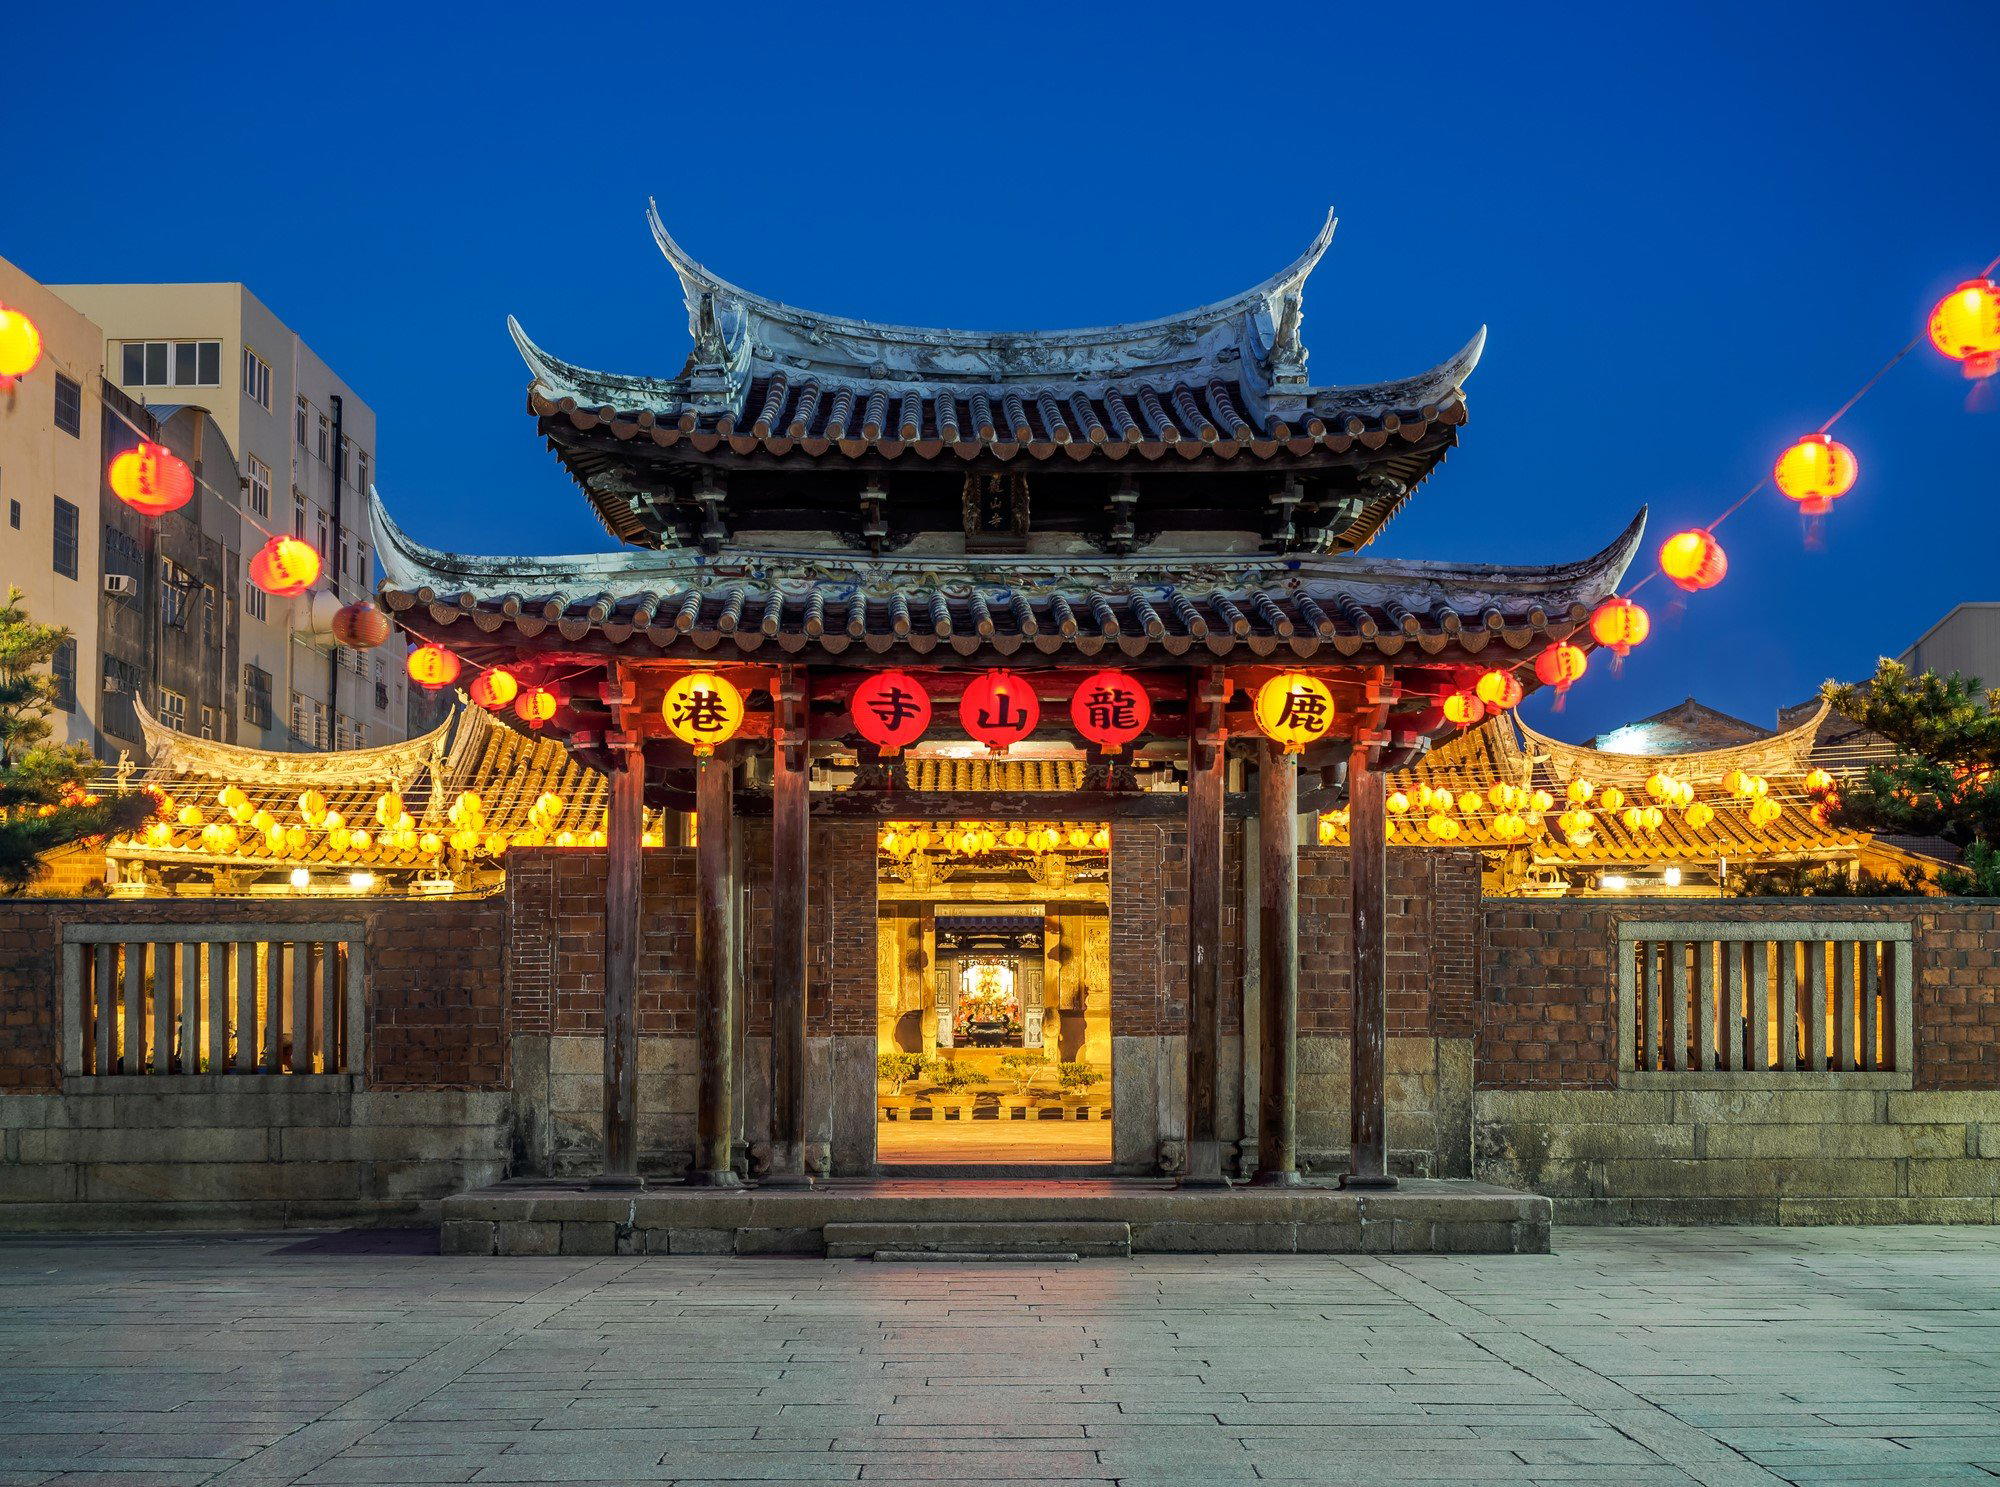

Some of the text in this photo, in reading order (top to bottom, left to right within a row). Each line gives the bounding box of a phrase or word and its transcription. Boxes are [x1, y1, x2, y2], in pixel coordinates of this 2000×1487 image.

[672, 690, 730, 732] 港
[866, 687, 921, 731] 寺
[977, 694, 1027, 731] 山
[1084, 687, 1139, 729] 龍
[1275, 686, 1327, 733] 鹿
